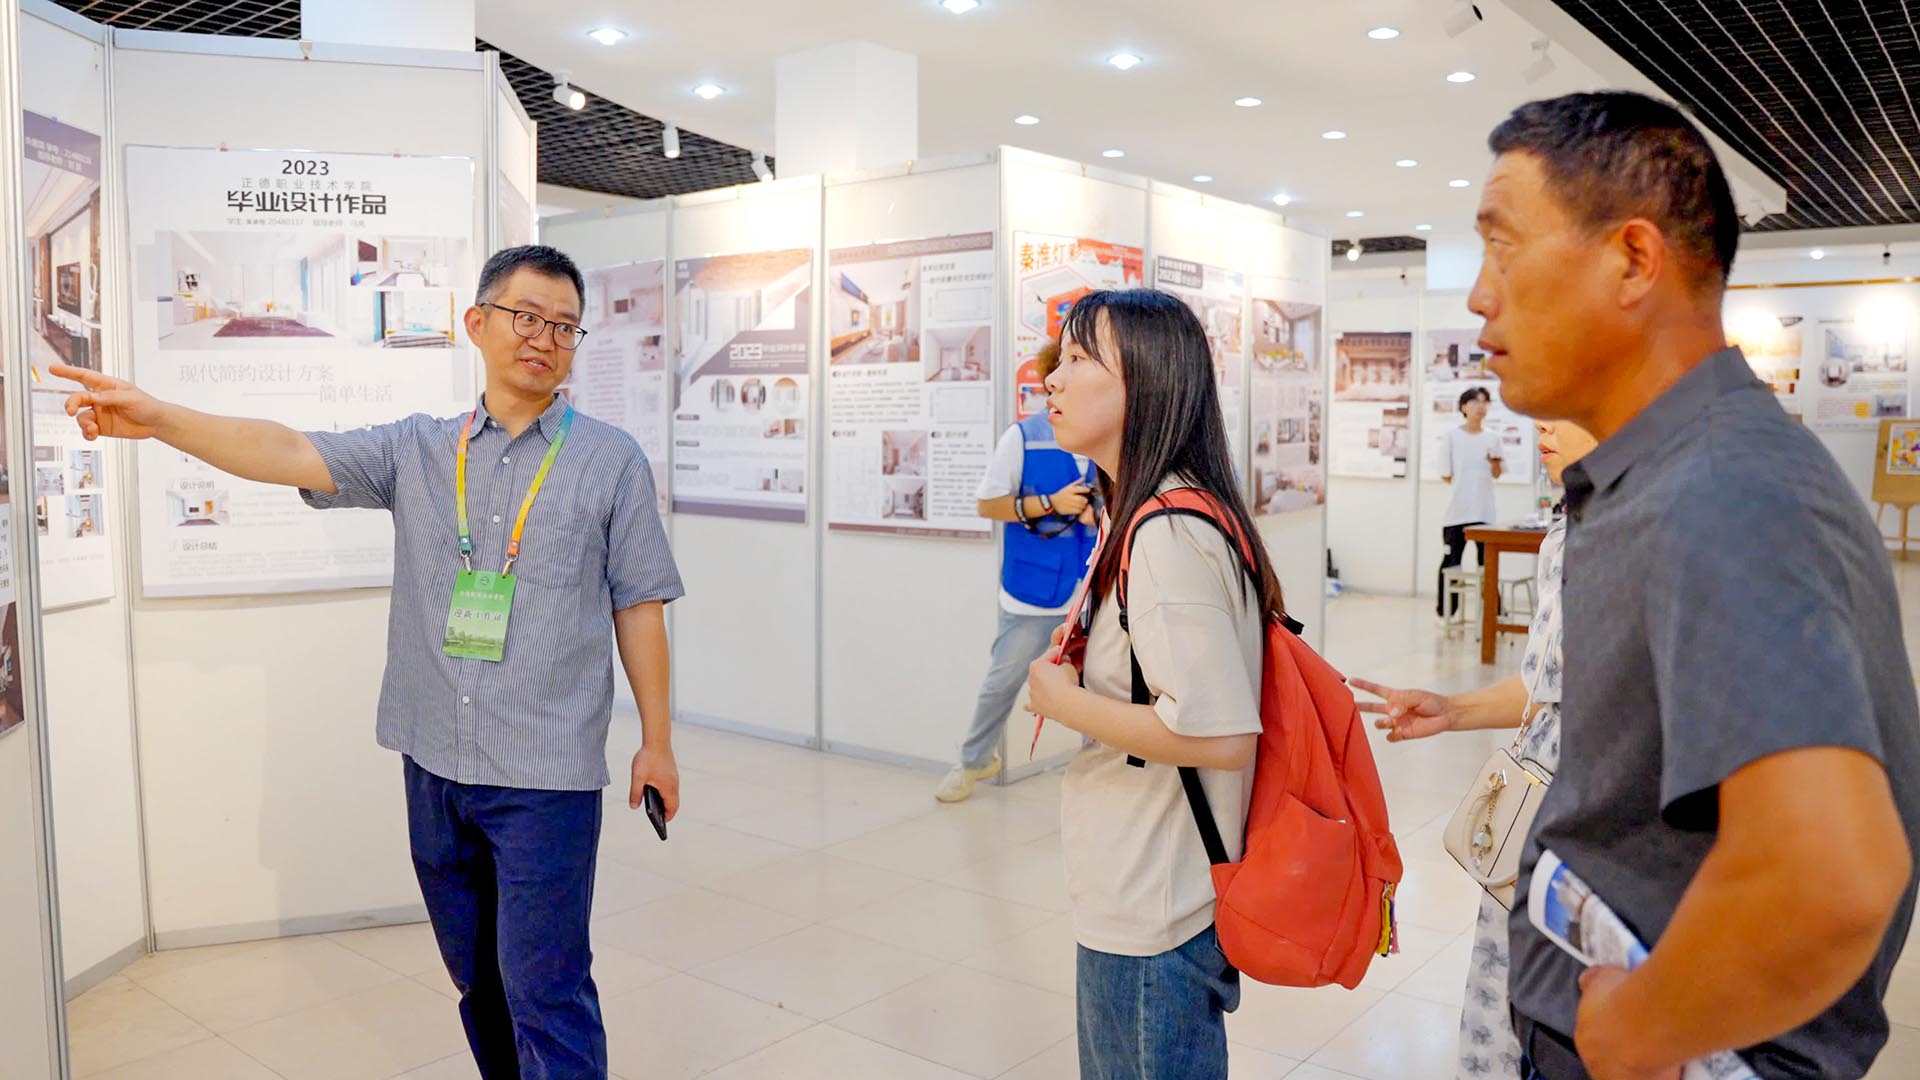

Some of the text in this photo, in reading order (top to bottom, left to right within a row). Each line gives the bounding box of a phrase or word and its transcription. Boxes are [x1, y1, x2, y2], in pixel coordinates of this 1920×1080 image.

[282, 159, 330, 176] 2023
[241, 177, 372, 191] 正德职业技术学院
[227, 190, 387, 215] 毕业设计作品
[178, 363, 336, 384] 现代简约设计方案
[319, 384, 393, 403] 简单生活
